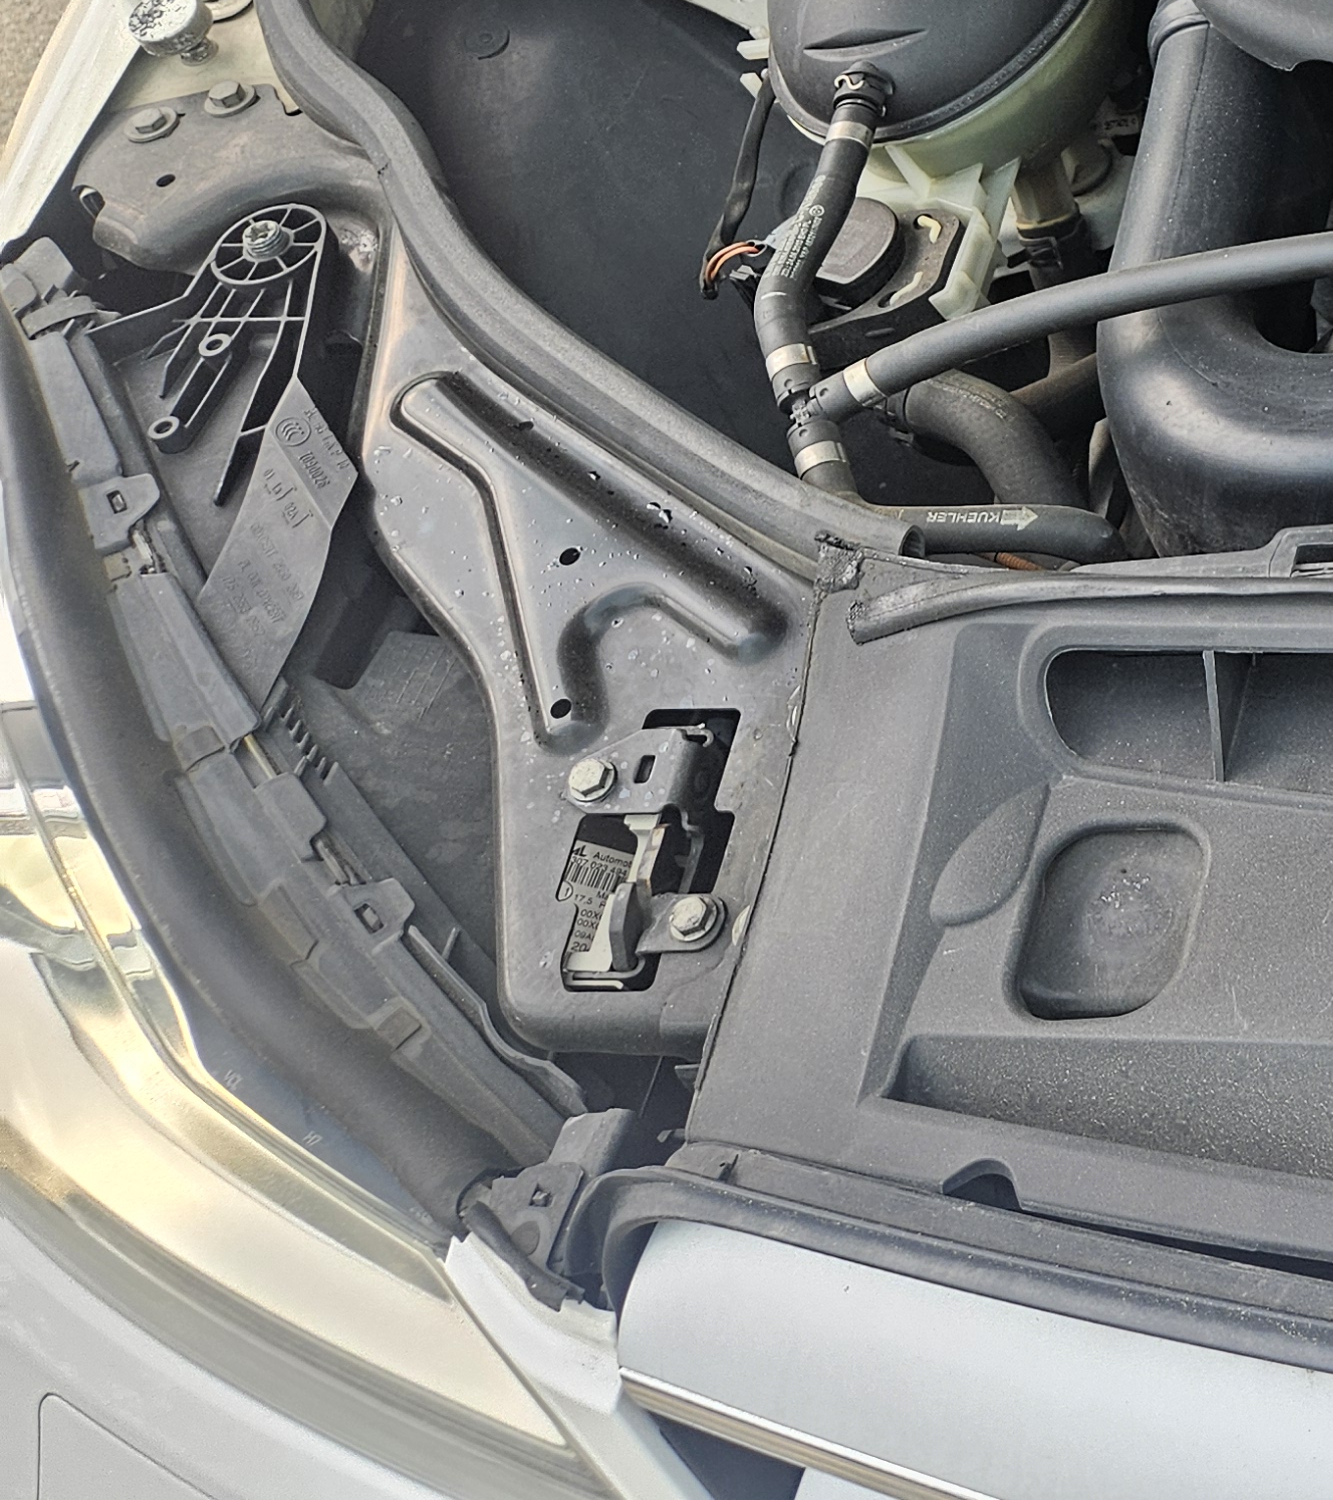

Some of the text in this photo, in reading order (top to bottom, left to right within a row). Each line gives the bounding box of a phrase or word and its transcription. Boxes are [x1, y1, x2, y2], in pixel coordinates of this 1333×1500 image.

[926, 510, 1000, 524] KUEHLER
[579, 908, 603, 920] 00X
[576, 917, 599, 930] 00X
